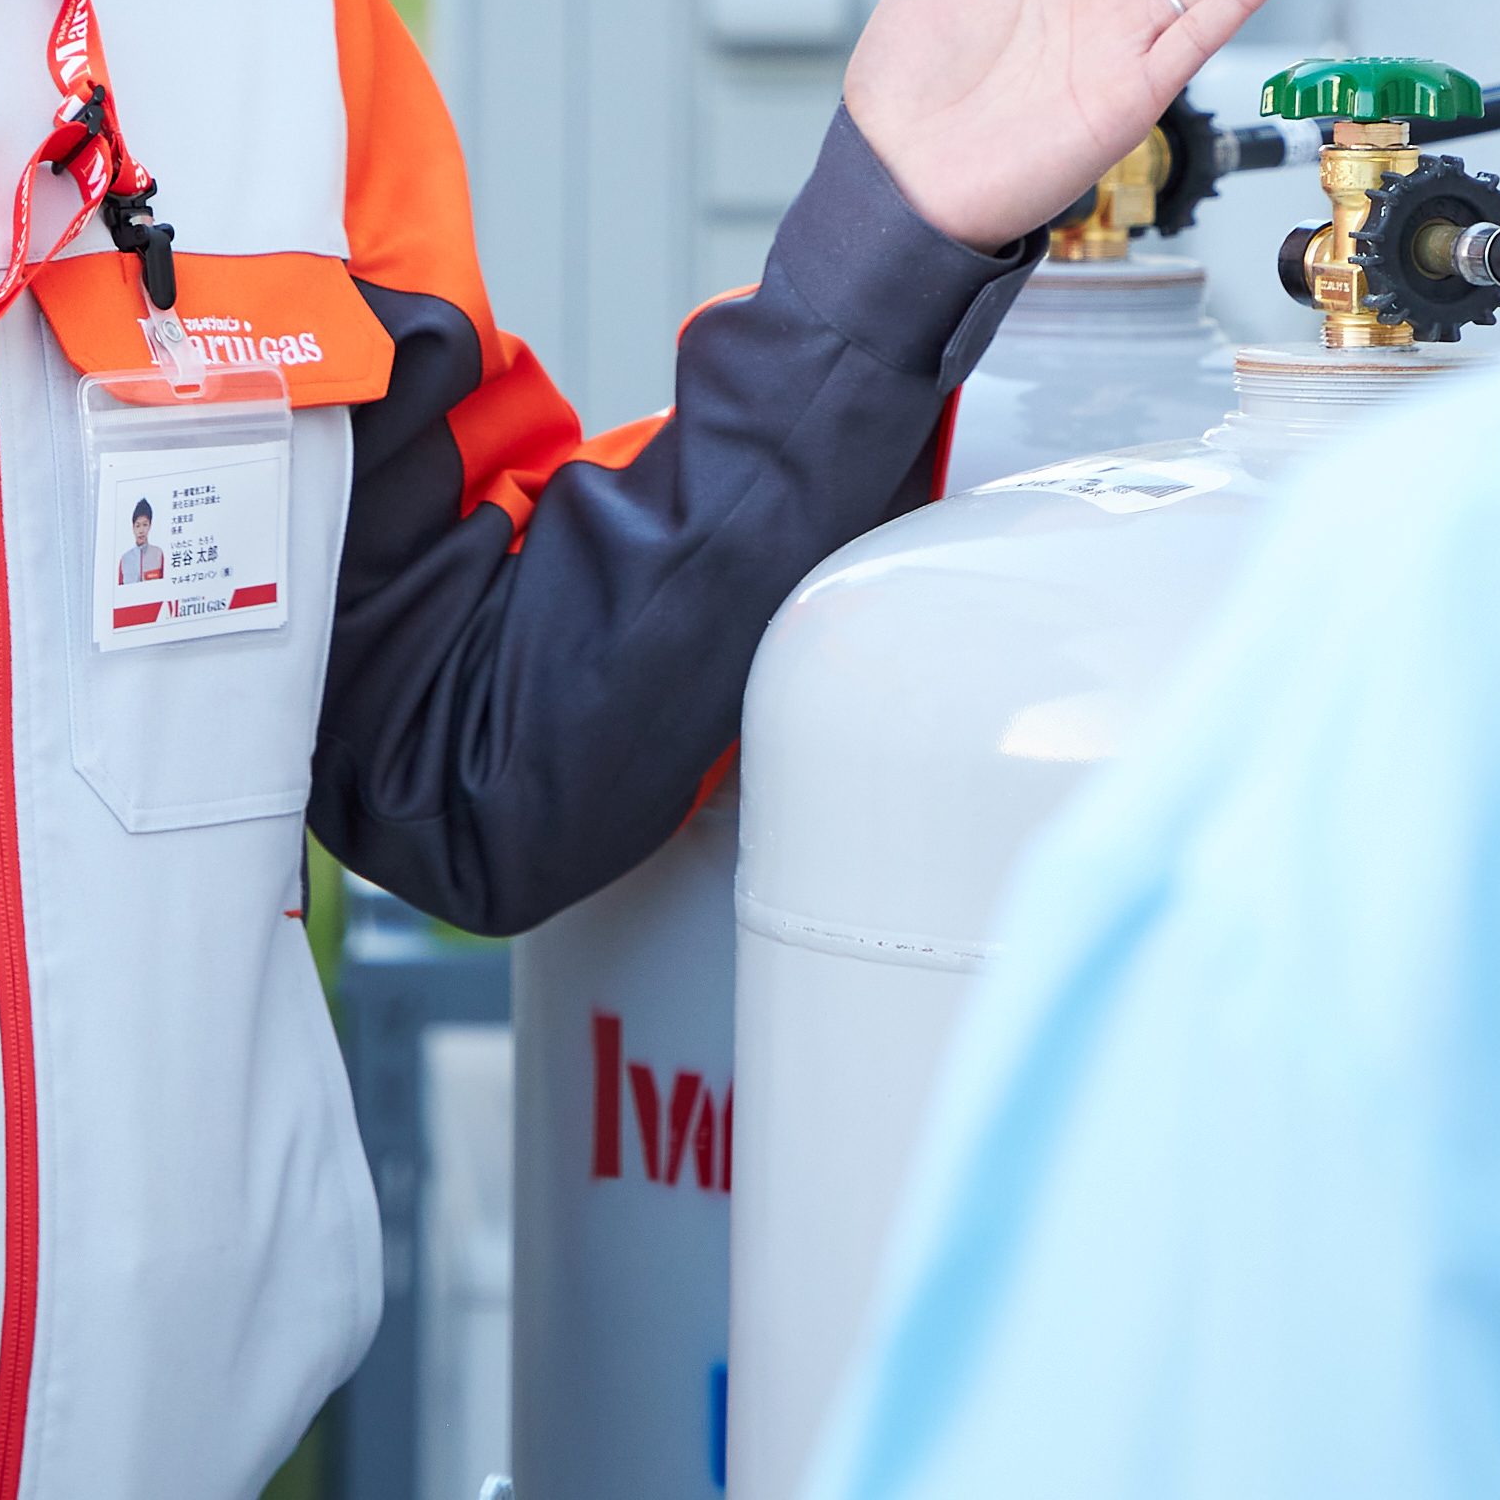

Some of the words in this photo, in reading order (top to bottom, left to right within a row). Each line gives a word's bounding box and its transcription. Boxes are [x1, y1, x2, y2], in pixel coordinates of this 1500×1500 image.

[259, 332, 323, 366] Gas
[171, 550, 193, 568] 岩谷
[166, 596, 206, 619] Marui
